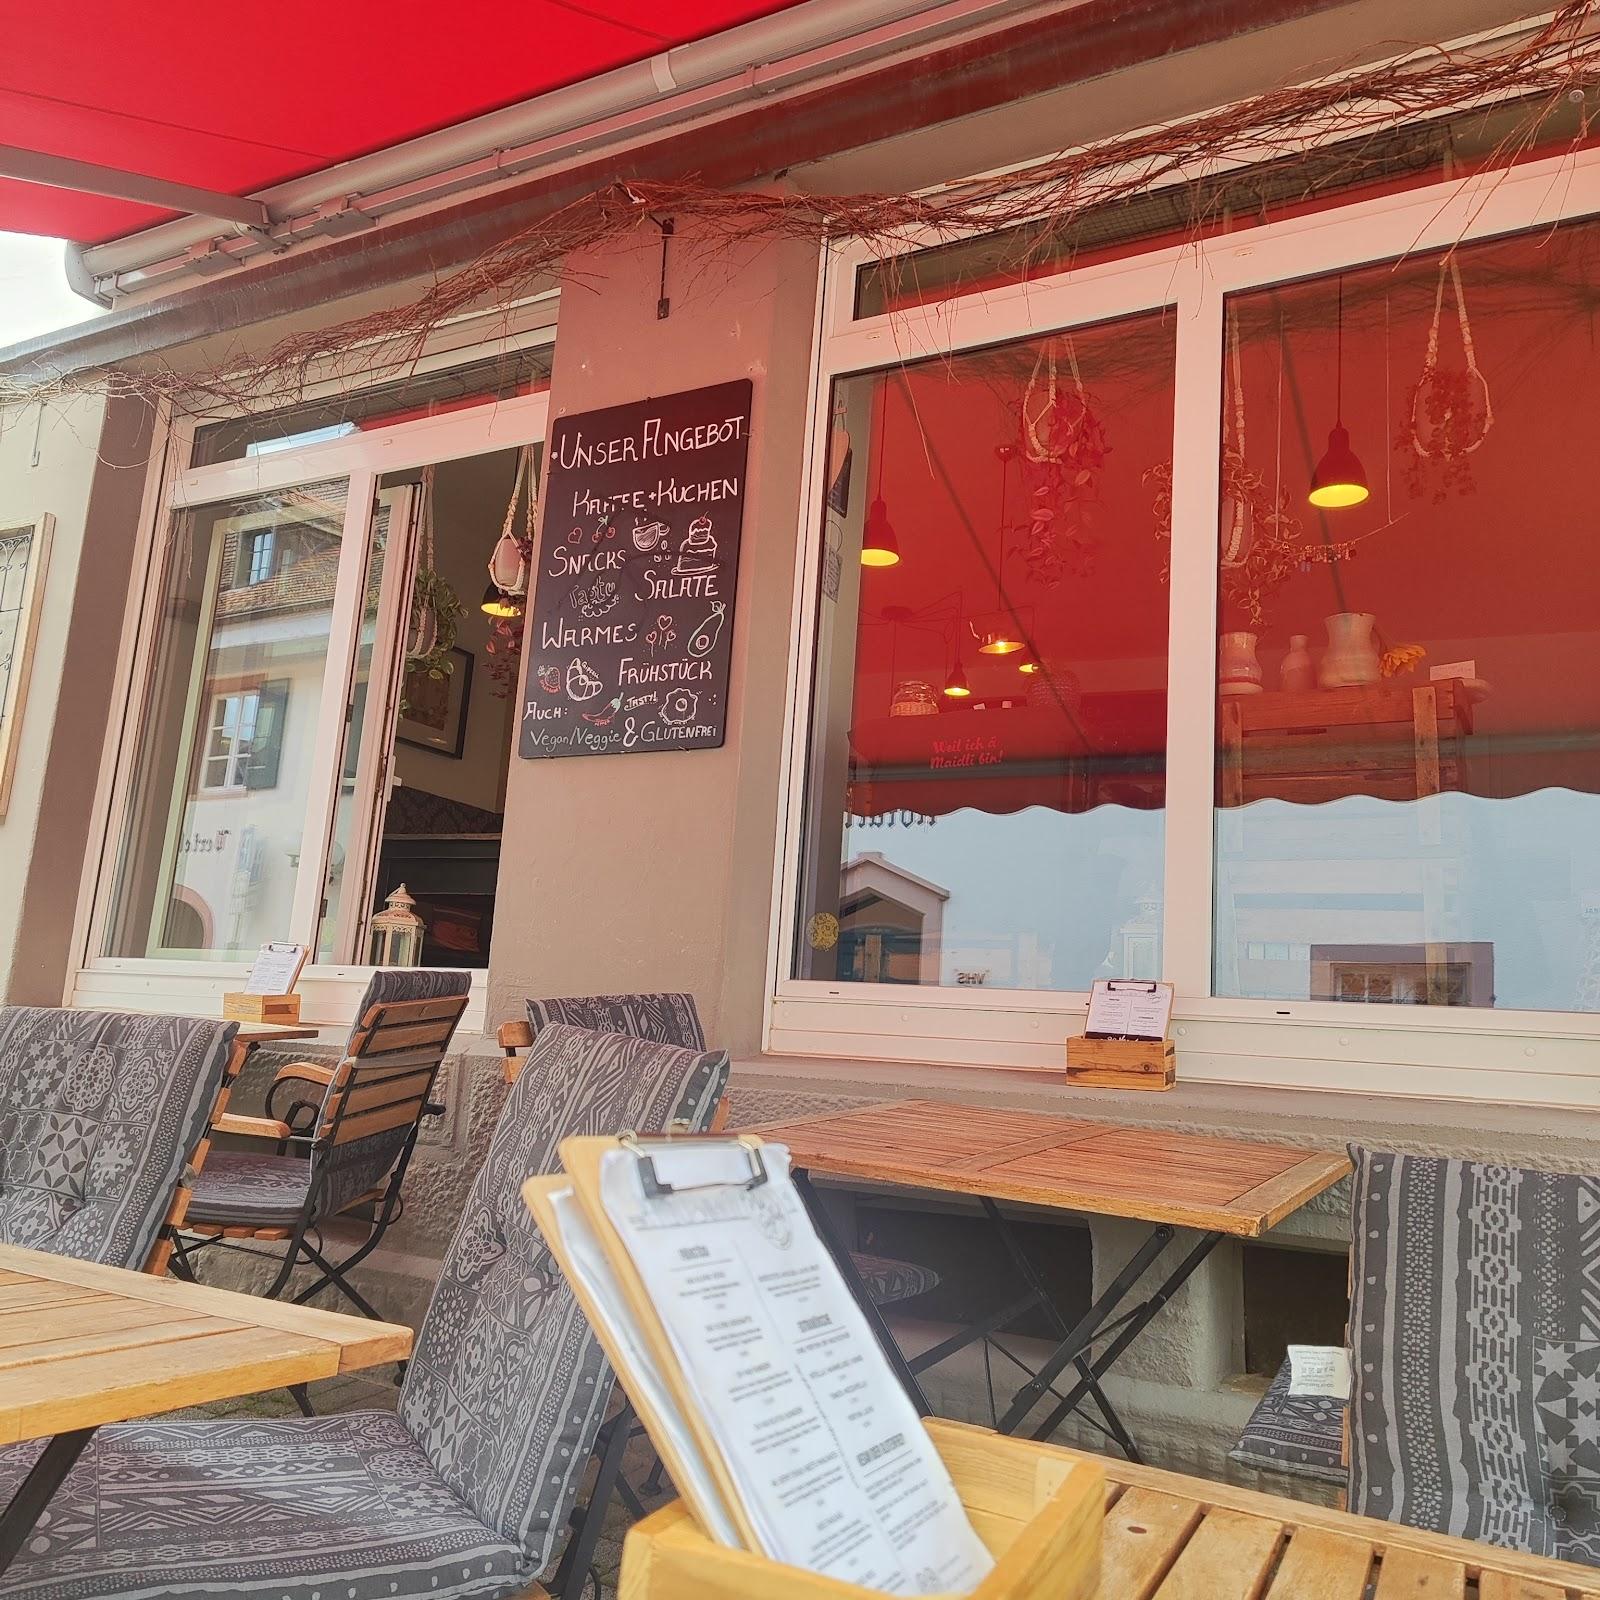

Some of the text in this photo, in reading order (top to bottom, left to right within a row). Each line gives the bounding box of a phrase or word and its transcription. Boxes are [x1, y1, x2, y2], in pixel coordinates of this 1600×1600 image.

[559, 415, 744, 469] UNSER ANGEBOT
[657, 478, 738, 506] KUCHEN
[548, 546, 627, 577] SNACKS
[635, 570, 719, 601] SALATE
[541, 618, 637, 649] WARMES
[618, 657, 713, 686] FRÜHSTÜCK
[523, 701, 568, 720] AUCH:
[622, 717, 639, 747] &
[933, 739, 961, 753] Weil
[965, 737, 984, 750] ich
[930, 753, 975, 769] Maidli
